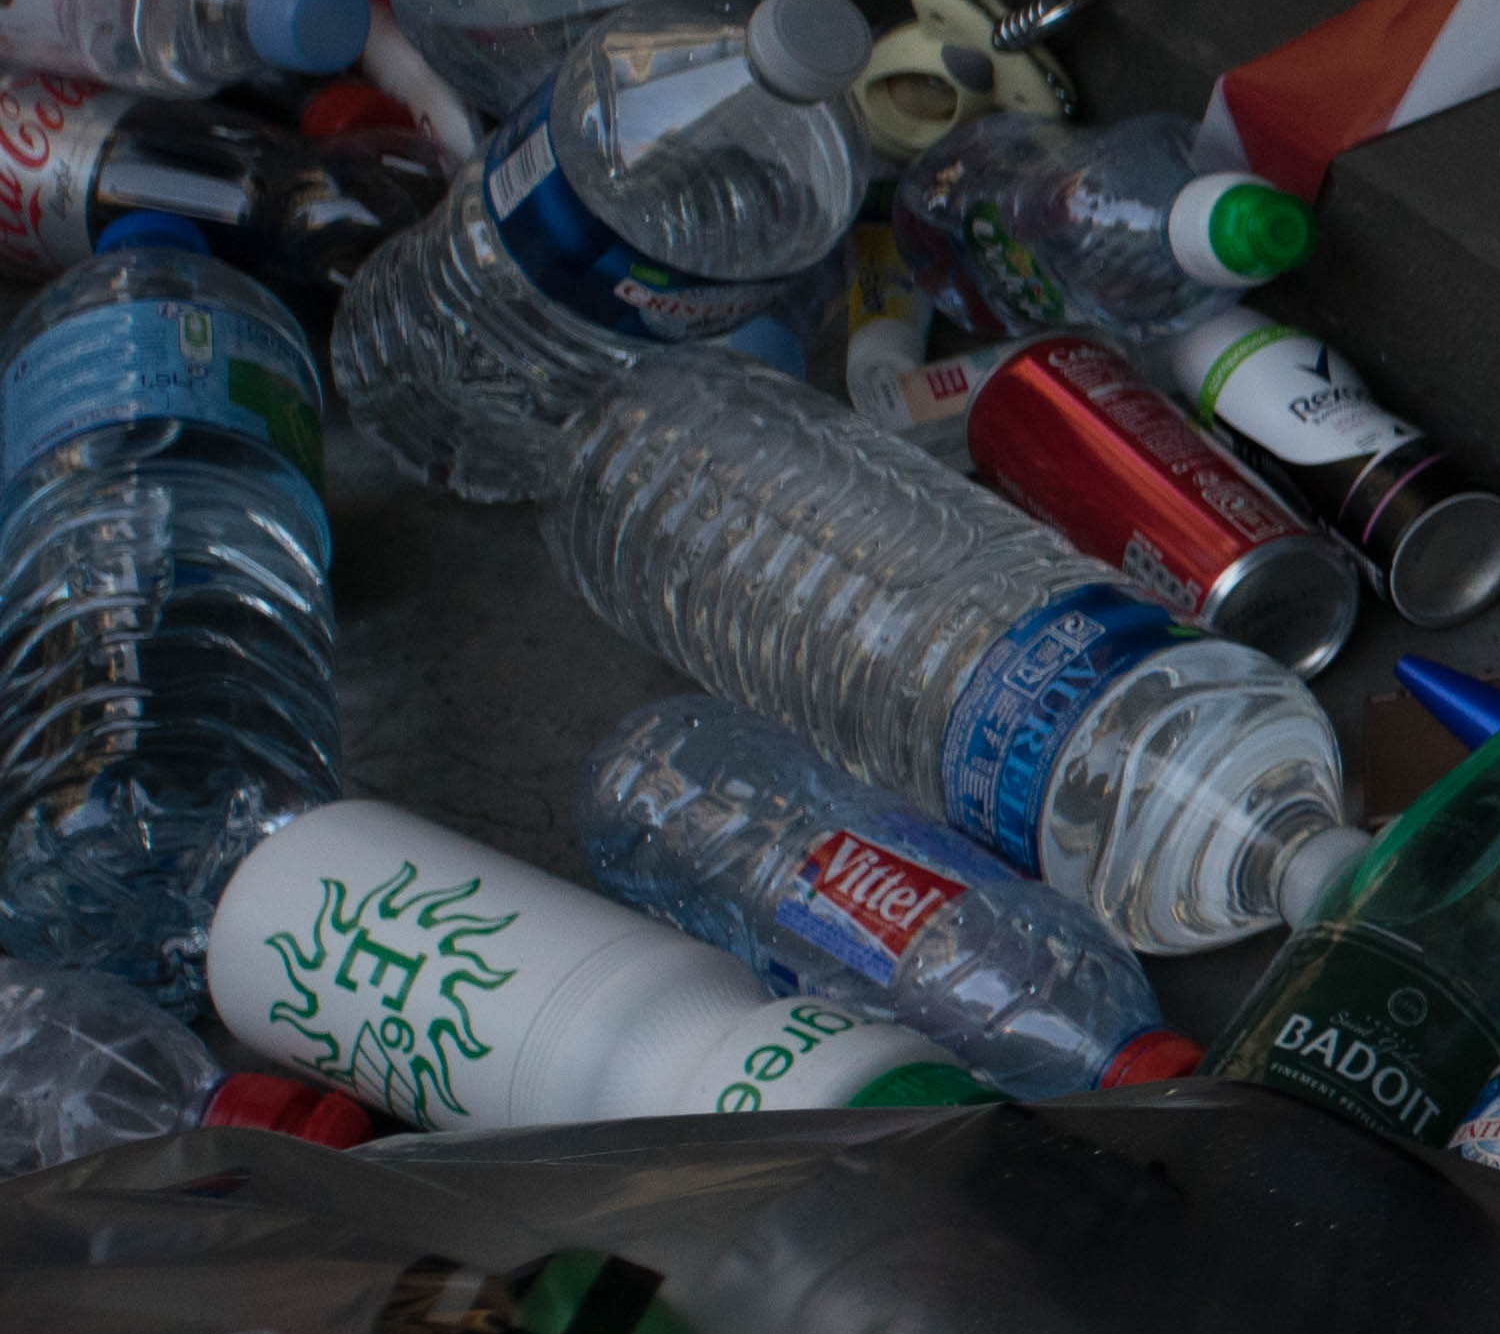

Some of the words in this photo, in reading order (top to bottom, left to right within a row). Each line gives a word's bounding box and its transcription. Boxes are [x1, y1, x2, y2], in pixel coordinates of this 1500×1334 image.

[824, 838, 943, 931] Vittel
[717, 1004, 855, 1113] gree
[1274, 1013, 1441, 1136] BADOIT
